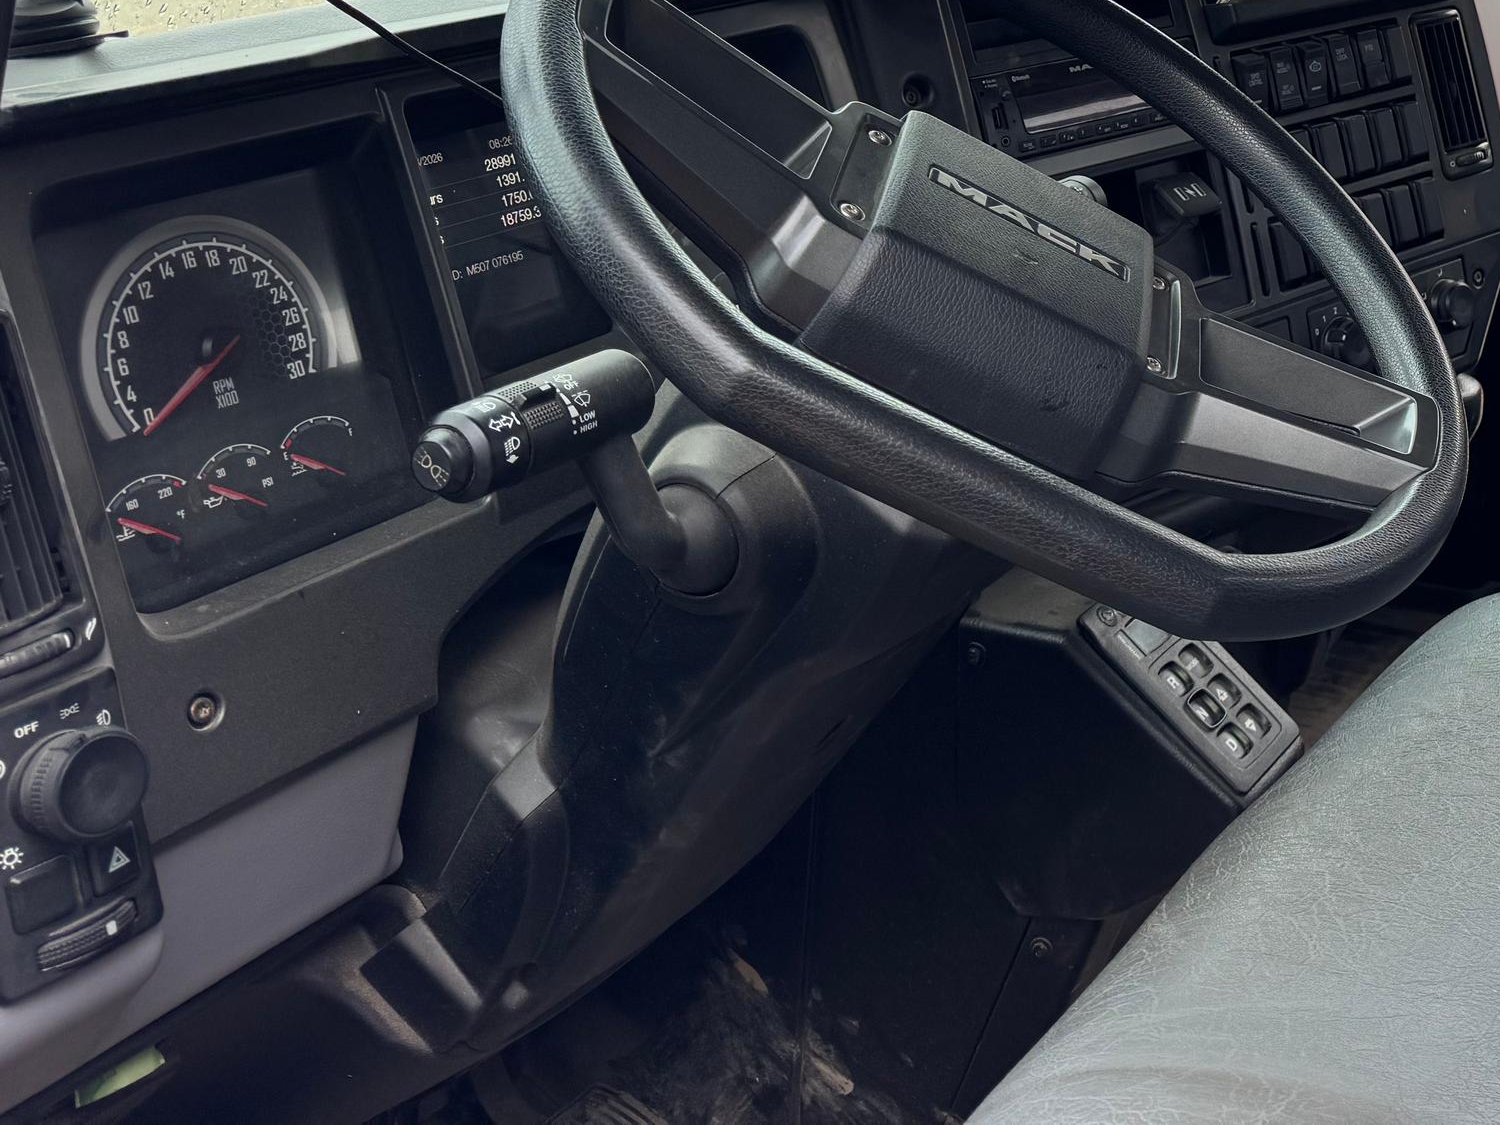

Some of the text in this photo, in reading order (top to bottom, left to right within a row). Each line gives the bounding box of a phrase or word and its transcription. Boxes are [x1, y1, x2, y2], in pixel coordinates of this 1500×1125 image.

[1068, 64, 1093, 74] MA
[484, 153, 516, 171] 28991
[496, 171, 525, 187] 1391.
[501, 205, 542, 227] 18759.3
[937, 170, 1120, 276] MACK
[181, 251, 197, 270] 16
[205, 249, 221, 268] 18
[229, 255, 248, 275] 20
[466, 260, 490, 276] M507
[491, 250, 524, 268] 076195
[159, 261, 175, 280] 14
[252, 270, 272, 288] 22
[137, 282, 154, 301] 12
[270, 286, 288, 304] 24
[122, 305, 140, 325] 10
[282, 308, 301, 326] 26
[117, 332, 130, 349] 8
[288, 333, 307, 352] 28
[117, 358, 129, 377] 6
[287, 360, 305, 380] 30
[213, 377, 235, 394] RPM
[126, 388, 137, 402] 4
[215, 391, 240, 409] X100
[579, 409, 596, 423] LOW
[580, 420, 598, 433] HIGH
[246, 456, 257, 468] 90
[215, 468, 226, 480] 30
[262, 477, 274, 489] PSI
[157, 486, 173, 500] 220
[125, 499, 140, 512] 160
[1166, 676, 1180, 689] R
[1195, 707, 1209, 721] N
[14, 721, 39, 738] OFF
[1225, 738, 1238, 751] D
